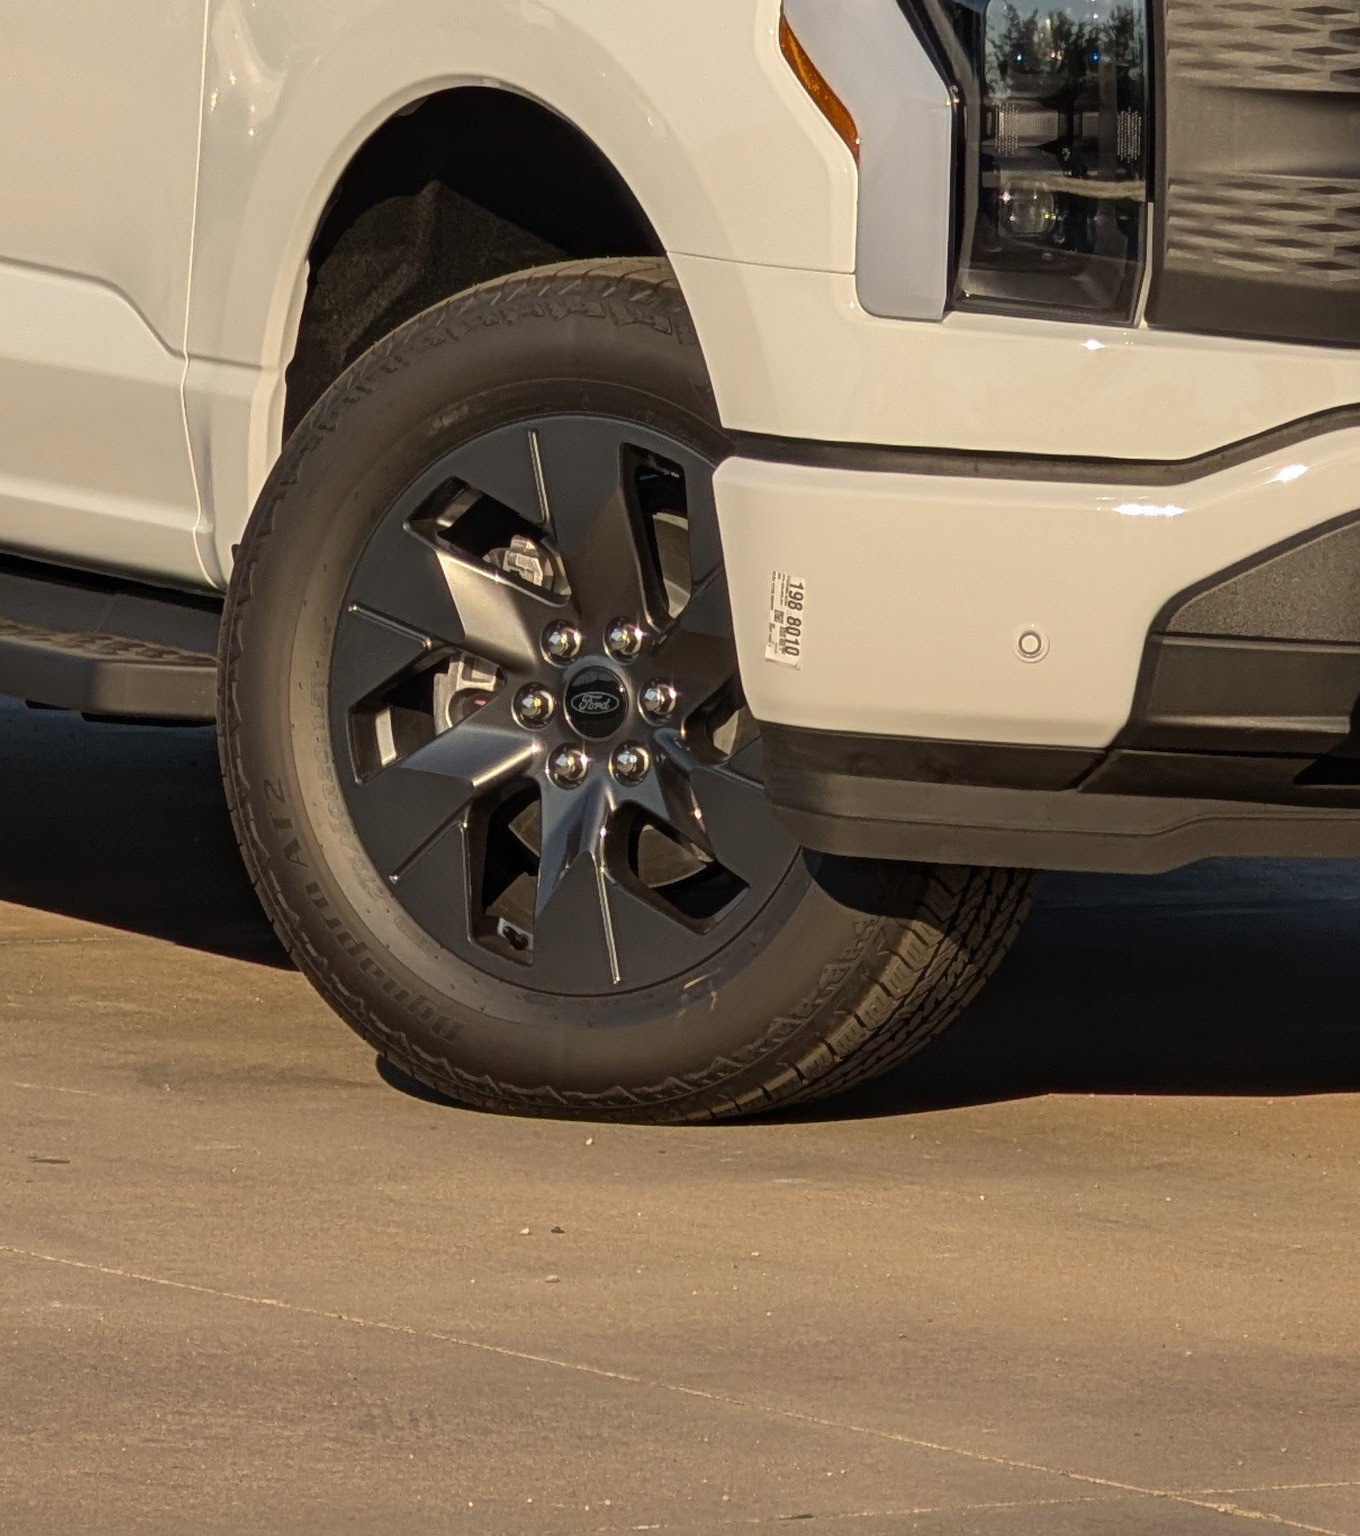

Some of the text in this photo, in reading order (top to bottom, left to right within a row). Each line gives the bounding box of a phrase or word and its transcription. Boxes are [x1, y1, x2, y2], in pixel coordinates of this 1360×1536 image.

[784, 581, 805, 657] 198 8010
[578, 693, 611, 712] Ford
[262, 777, 310, 870] AT2
